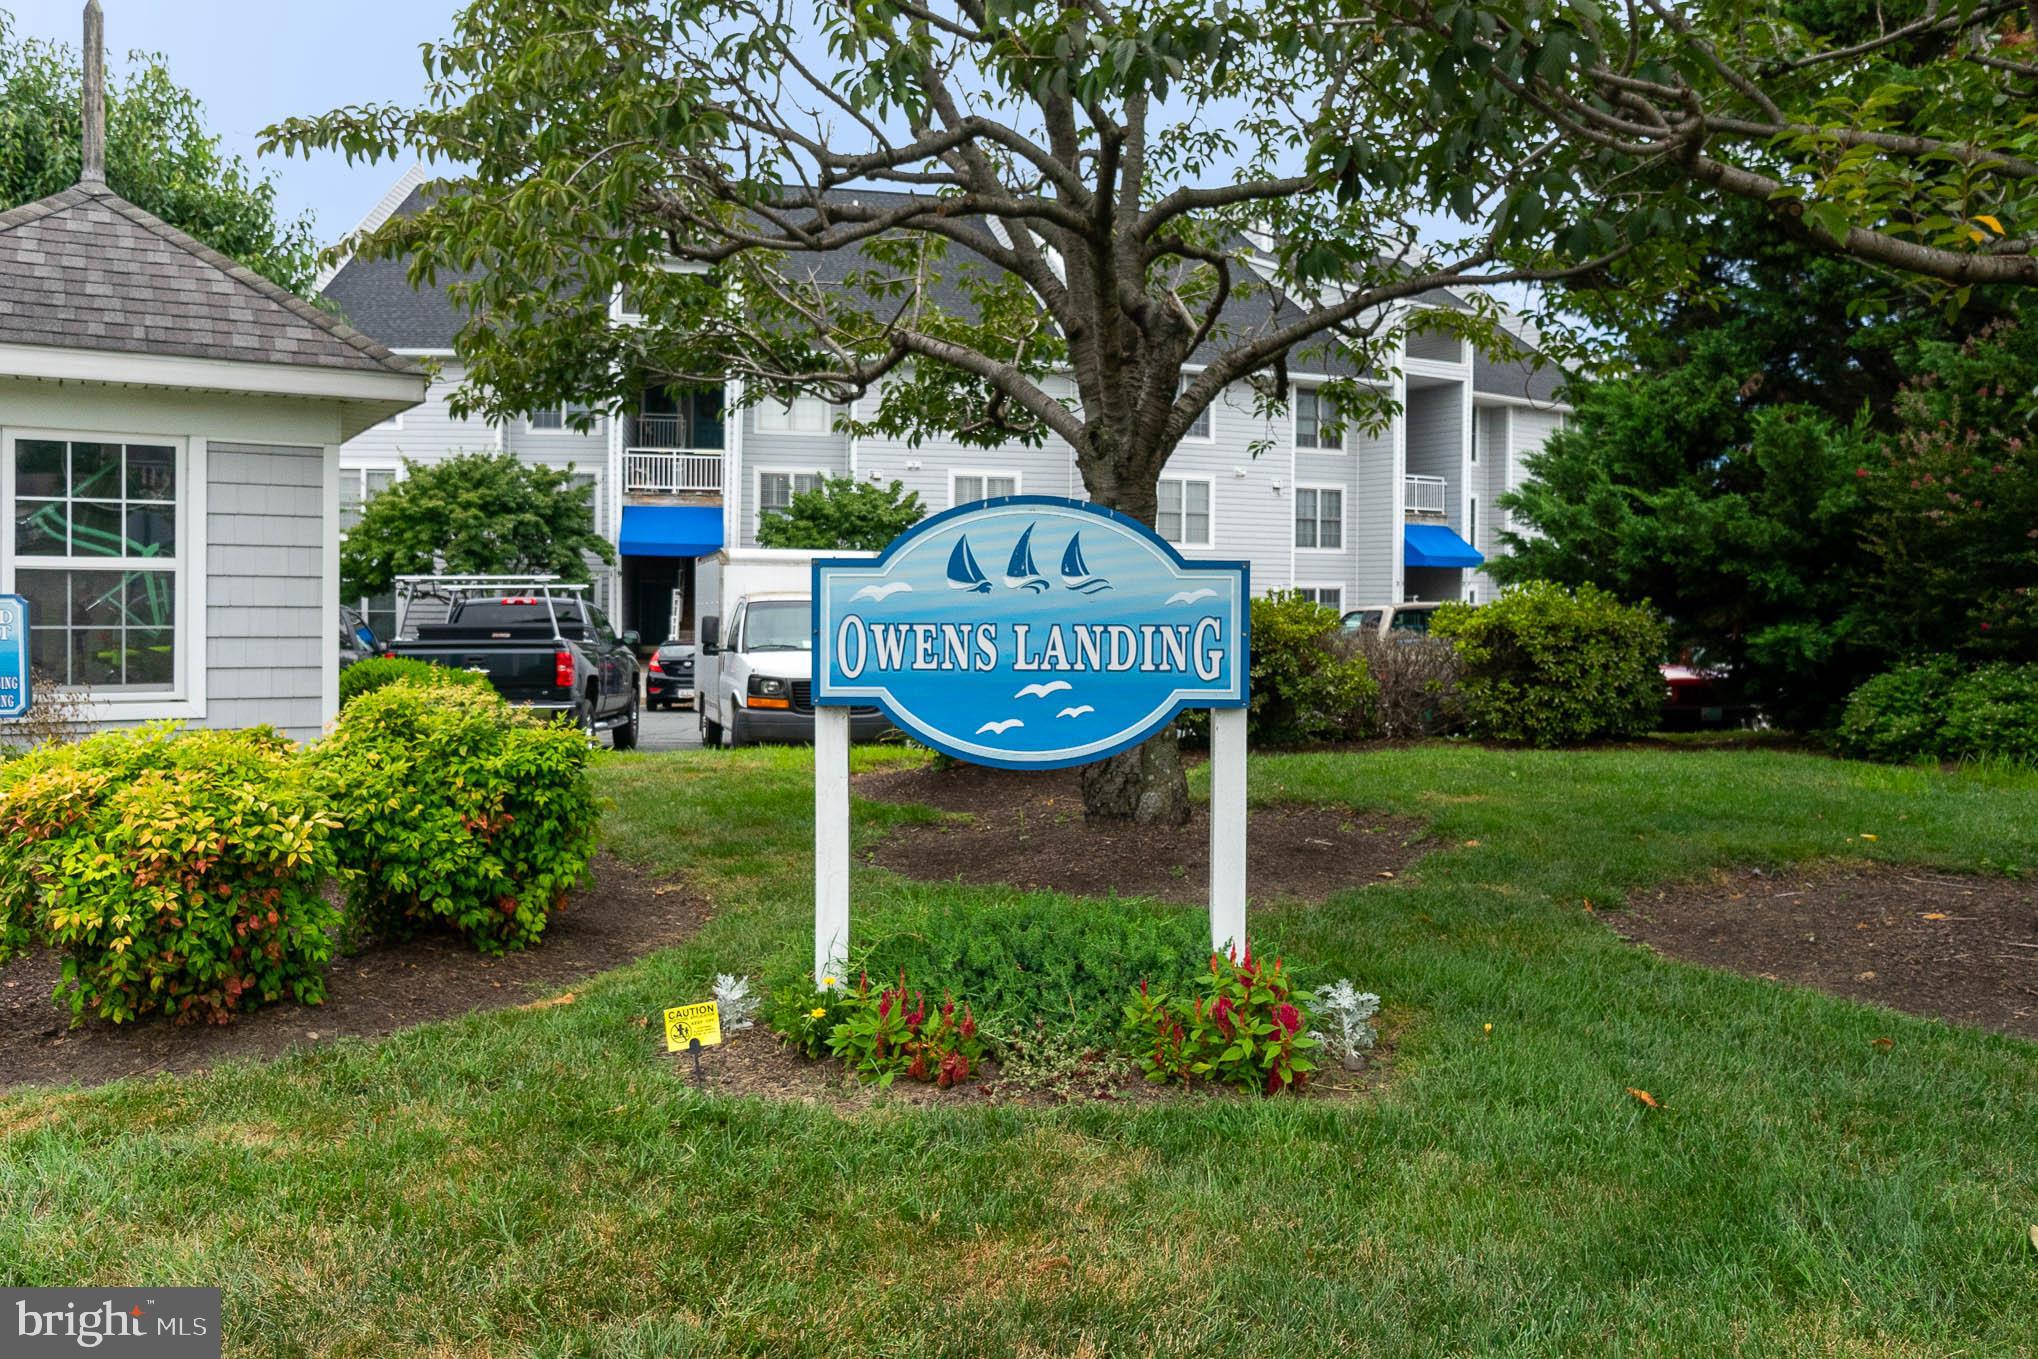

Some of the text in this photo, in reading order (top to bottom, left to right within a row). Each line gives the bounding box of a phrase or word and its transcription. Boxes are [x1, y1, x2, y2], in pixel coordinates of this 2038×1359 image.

[837, 614, 1224, 681] OWENS LANDING
[668, 1005, 714, 1020] CAUTION
